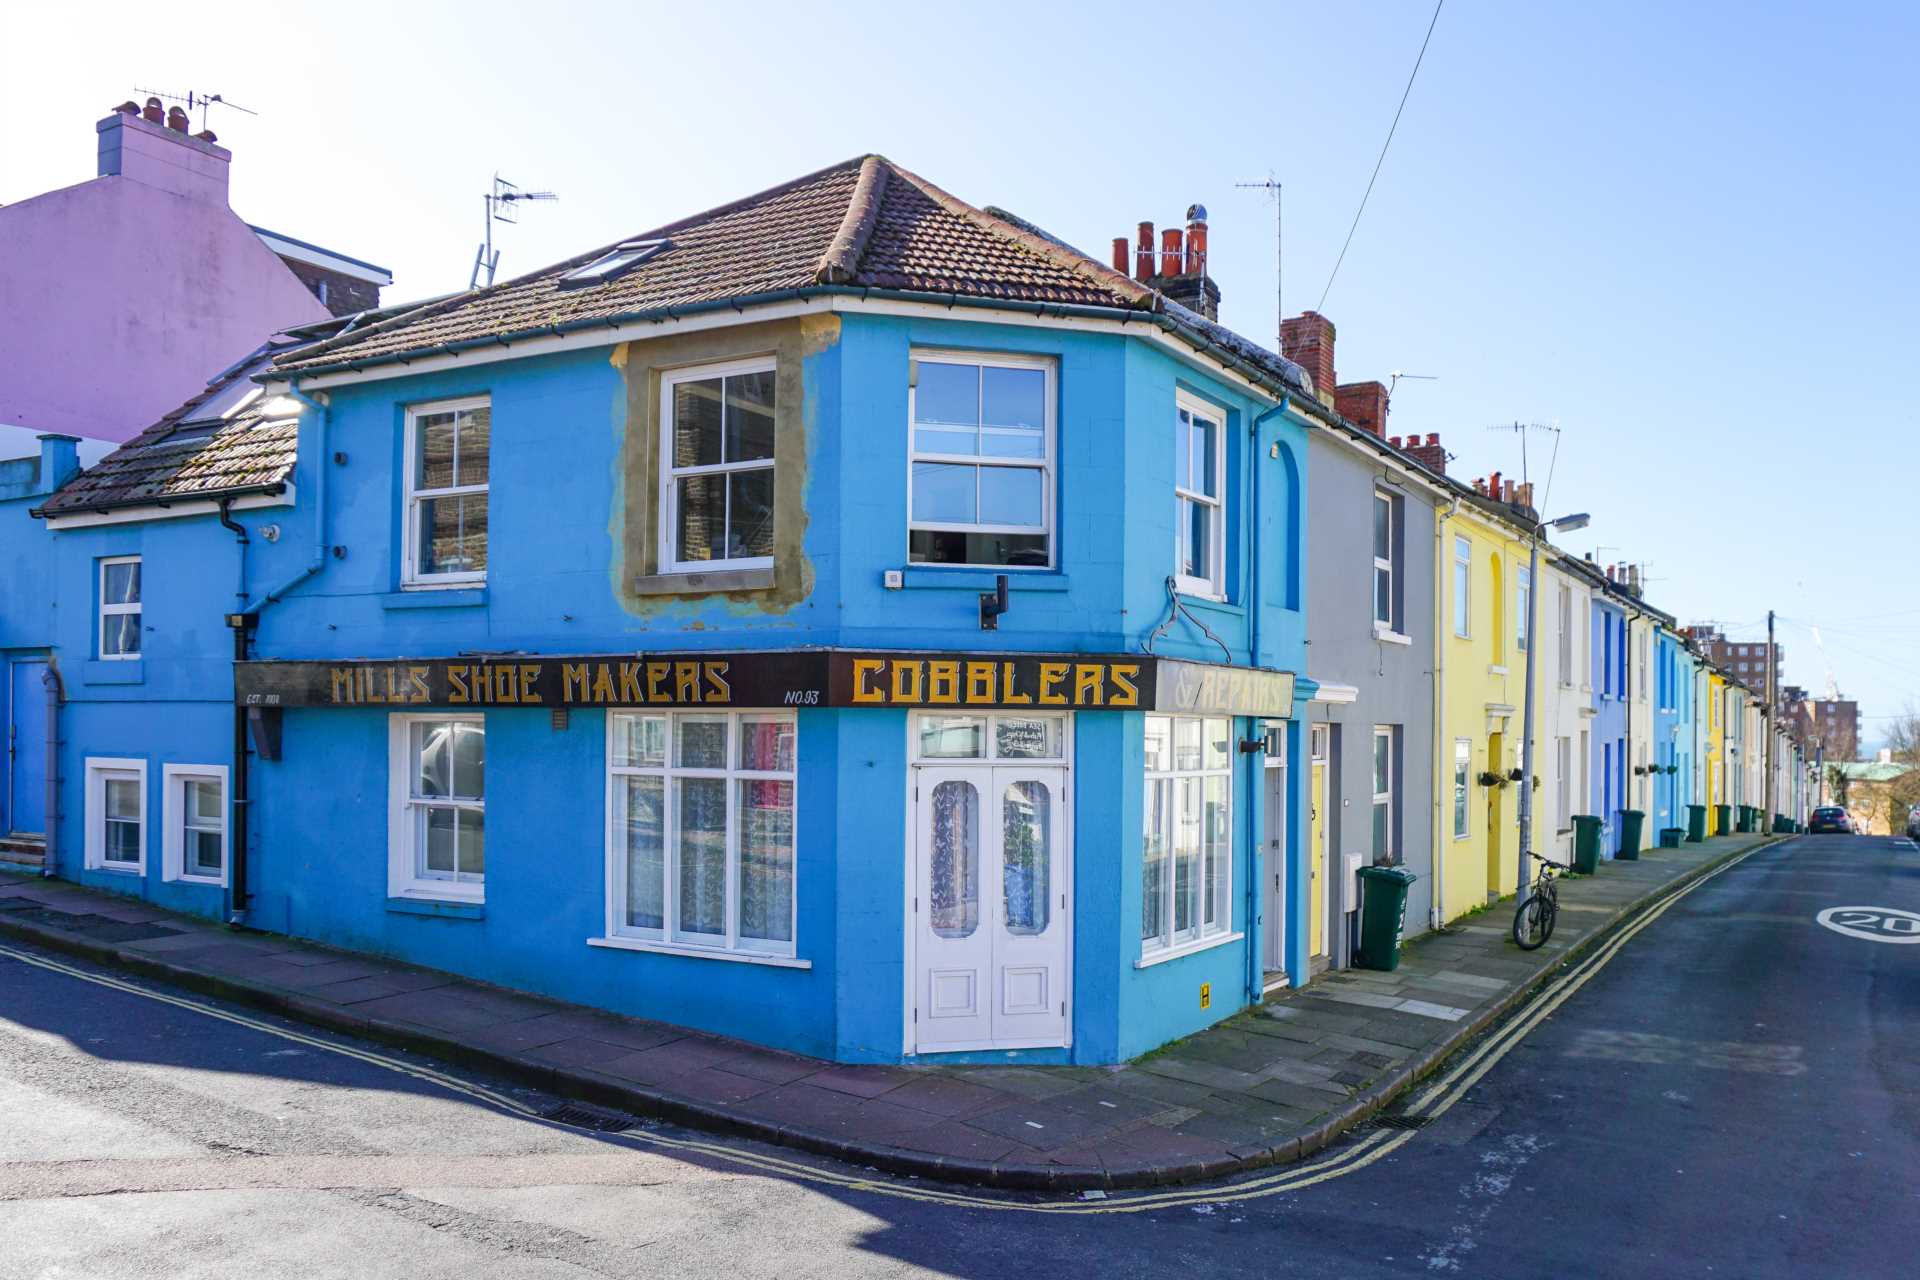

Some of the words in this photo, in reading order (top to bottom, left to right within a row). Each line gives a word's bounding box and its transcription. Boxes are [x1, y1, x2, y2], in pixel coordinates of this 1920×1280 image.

[330, 664, 431, 703] MILLS
[448, 663, 542, 703] SHOE
[561, 661, 731, 702] MAKERS
[852, 659, 1141, 705] COBBLERS
[1840, 912, 1920, 933] 20
